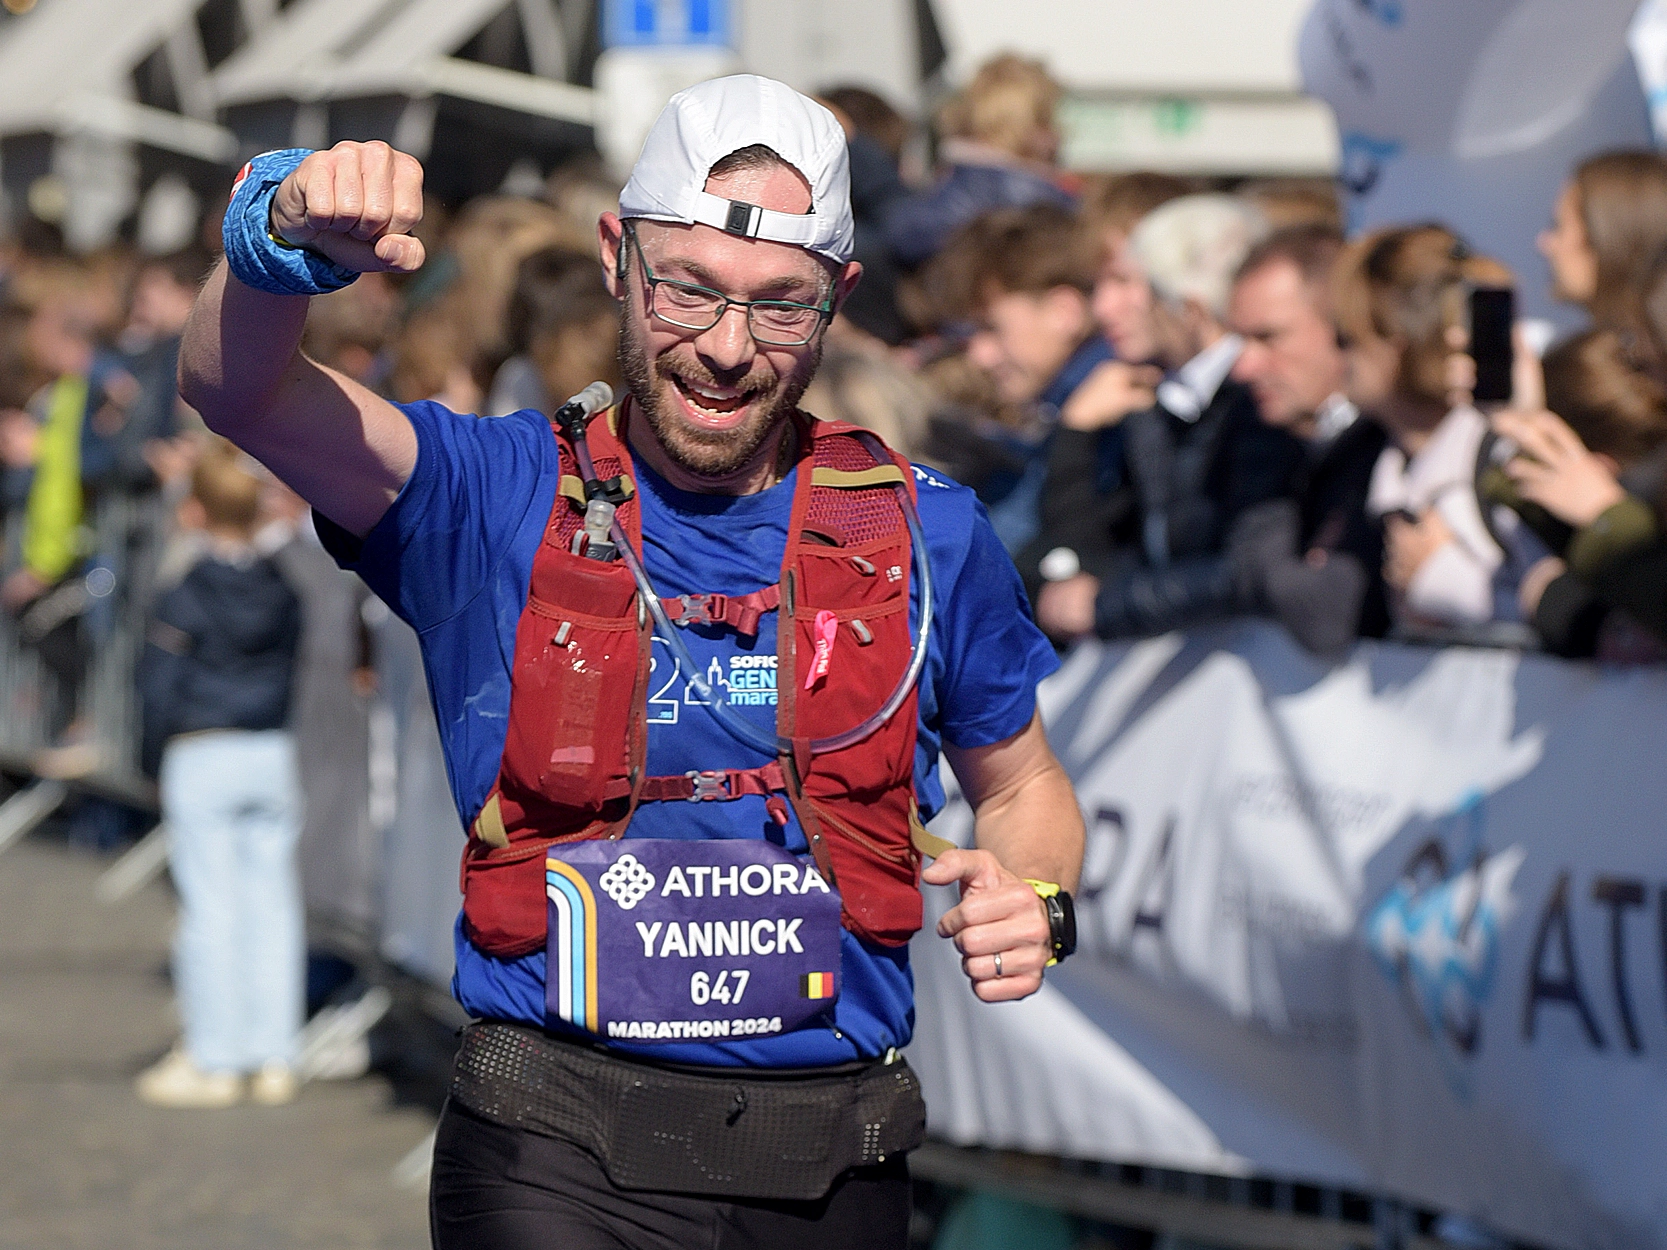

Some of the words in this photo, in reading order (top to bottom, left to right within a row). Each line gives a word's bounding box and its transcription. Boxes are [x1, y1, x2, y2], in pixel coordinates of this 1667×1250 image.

[660, 863, 831, 898] ATHORA
[635, 918, 804, 958] YANNICK
[1521, 871, 1667, 1055] AT
[690, 969, 751, 1006] 647
[607, 1020, 730, 1040] MARATHON
[731, 1017, 783, 1037] 2024
